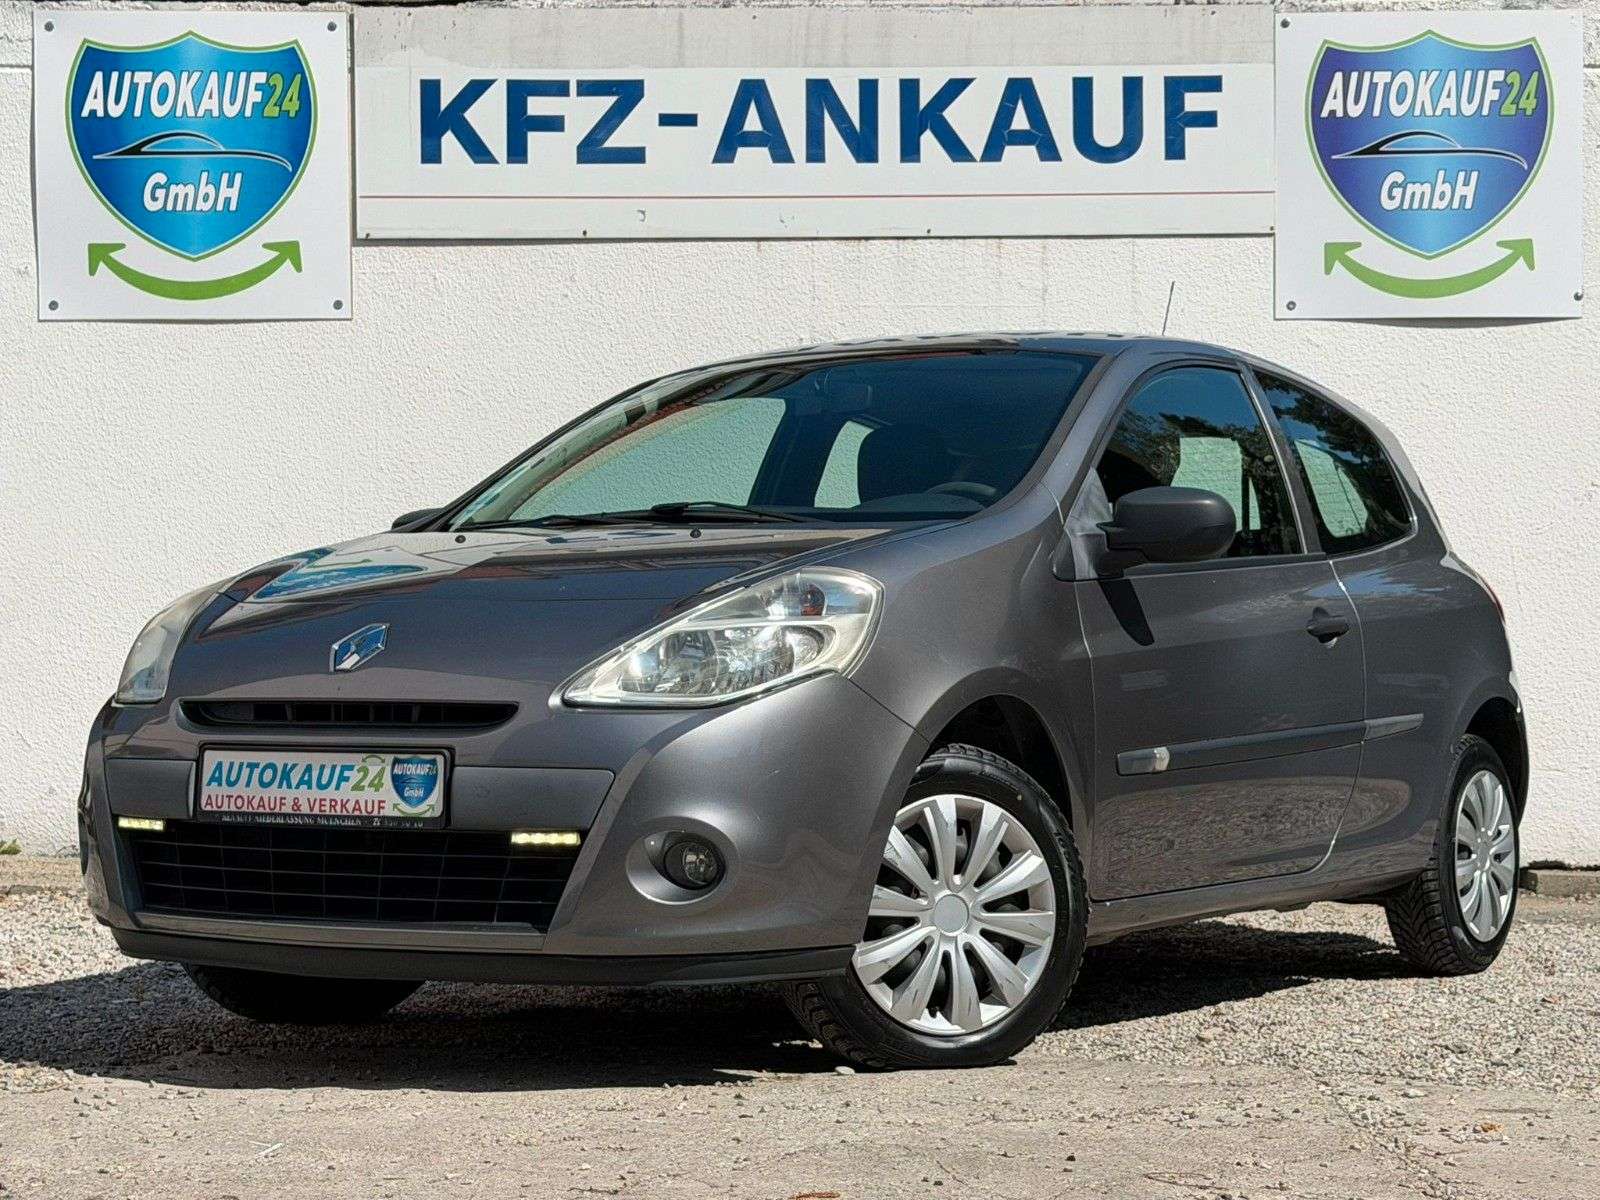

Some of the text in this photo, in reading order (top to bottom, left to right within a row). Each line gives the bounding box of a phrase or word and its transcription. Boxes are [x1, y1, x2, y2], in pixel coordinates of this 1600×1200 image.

[80, 70, 302, 119] AUTOKAUF24
[1320, 69, 1540, 118] AUTOKAUF24
[418, 75, 1223, 165] KFZ-ANKAUF
[142, 171, 243, 212] GmbH
[1380, 169, 1480, 211] GmbH
[206, 760, 386, 792] AUTOKAUF24
[203, 794, 387, 815] AUTOKAUF & VERKAUF
